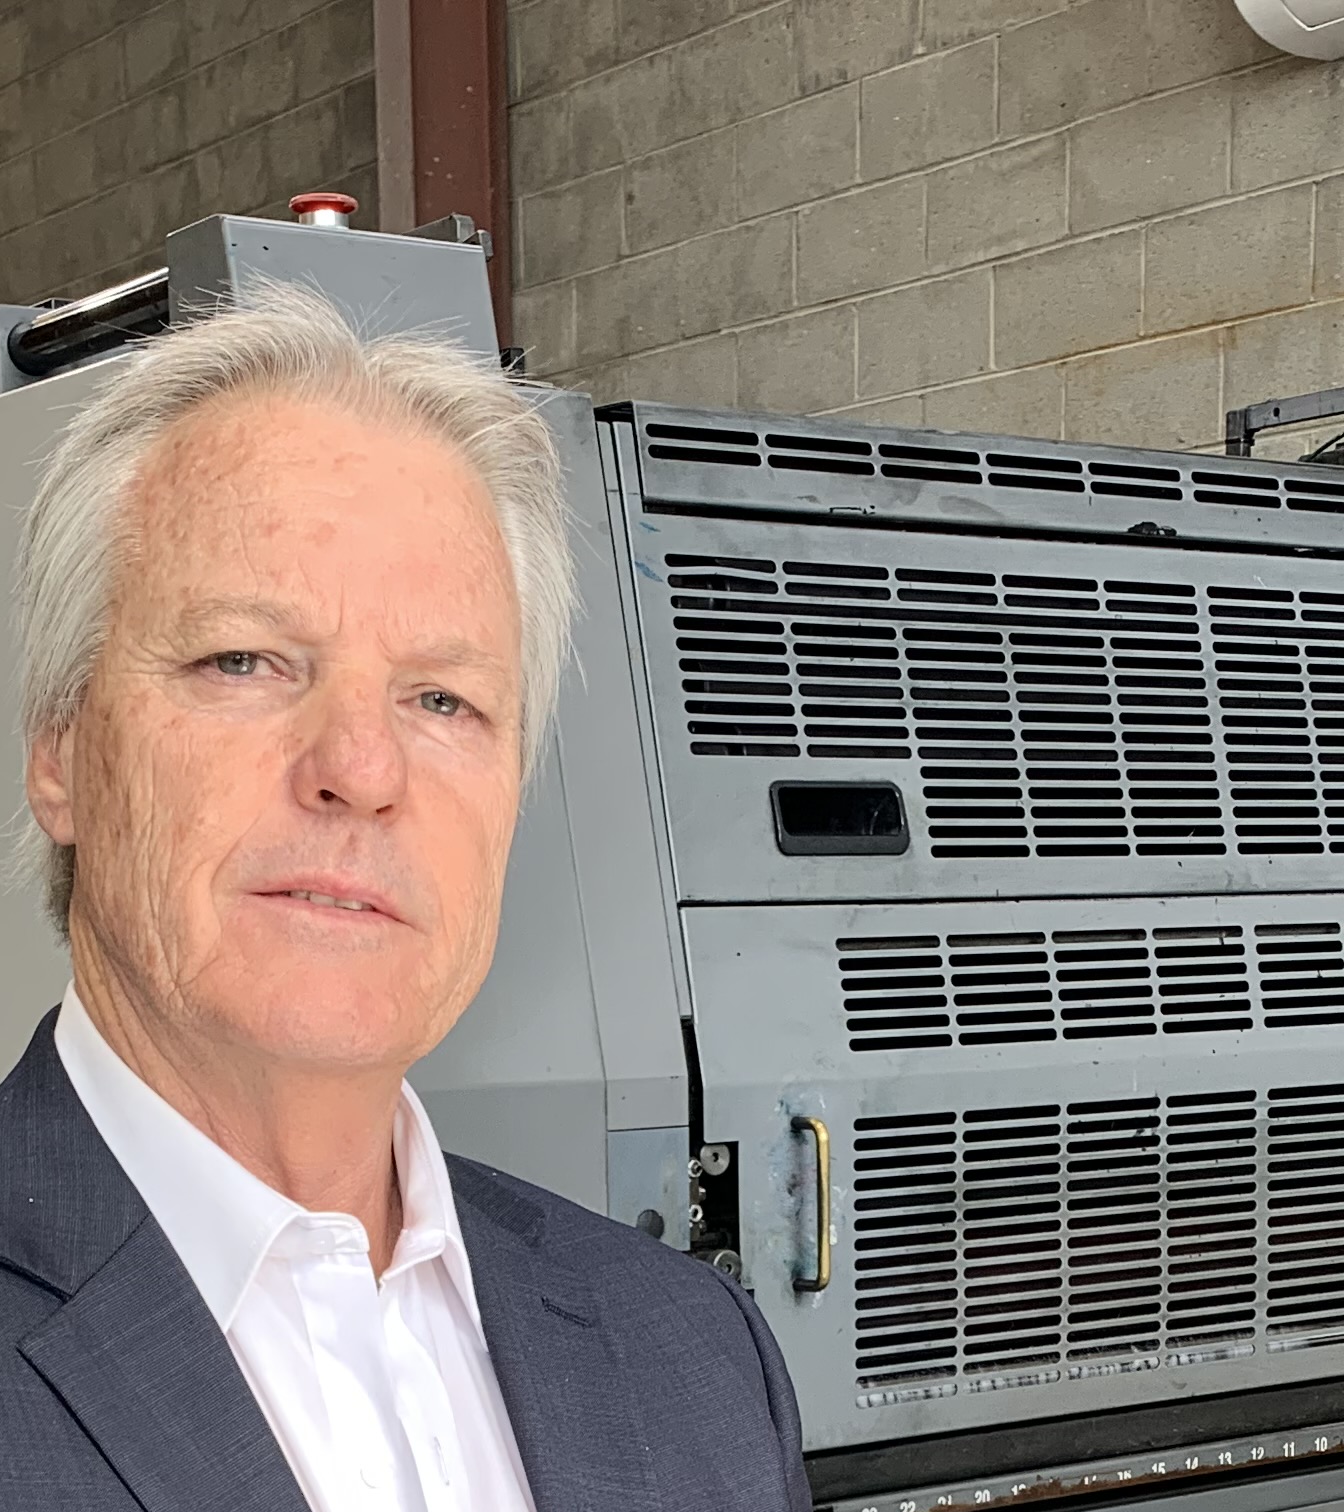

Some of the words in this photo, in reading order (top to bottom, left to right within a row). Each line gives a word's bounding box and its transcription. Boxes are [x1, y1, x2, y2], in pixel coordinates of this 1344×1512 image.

[1250, 1446, 1264, 1461] 12
[1283, 1442, 1296, 1458] 11
[1314, 1436, 1328, 1452] 10
